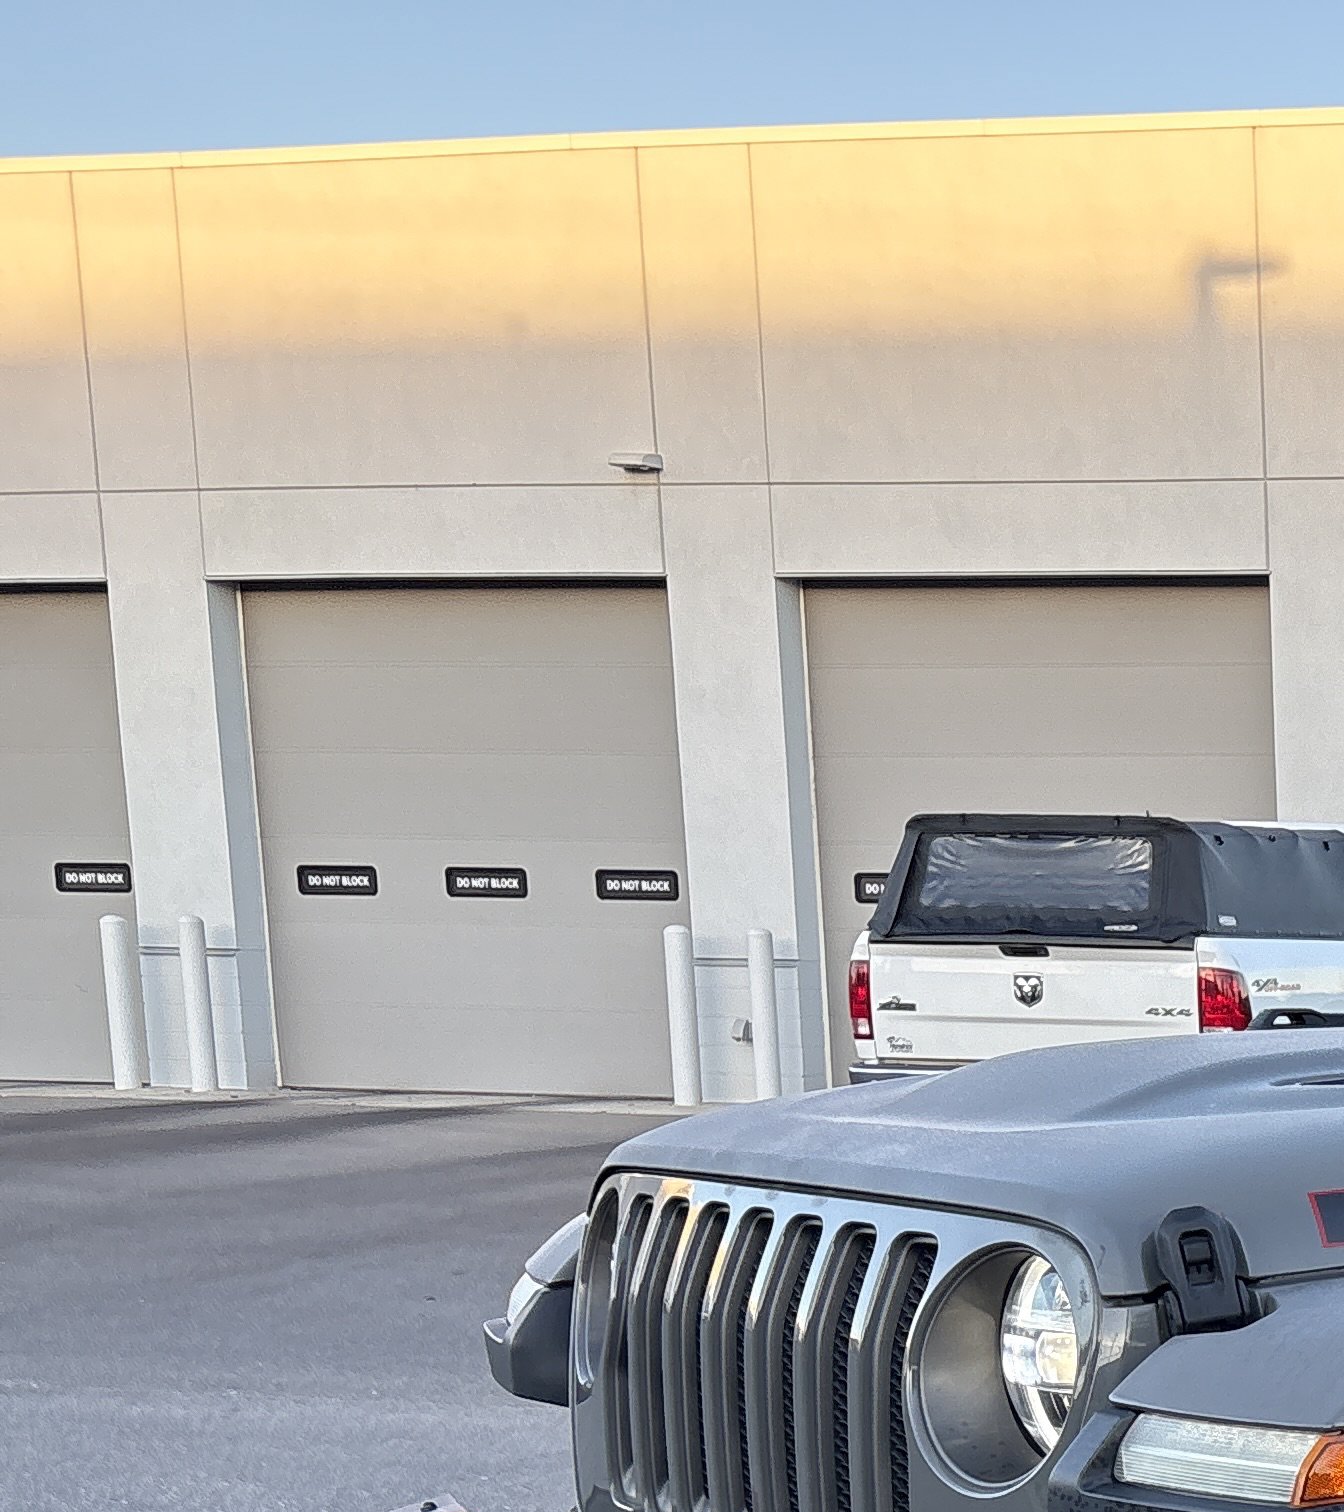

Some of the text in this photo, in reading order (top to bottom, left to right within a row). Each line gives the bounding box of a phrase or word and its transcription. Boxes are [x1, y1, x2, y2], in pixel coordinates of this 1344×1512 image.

[65, 872, 125, 884] DO NOT BLOCK
[308, 875, 370, 887] DO NOT BLOCK
[456, 876, 519, 890] DO NOT BLOCK
[606, 879, 671, 892] DO NOT BLOCK
[865, 883, 880, 895] DO
